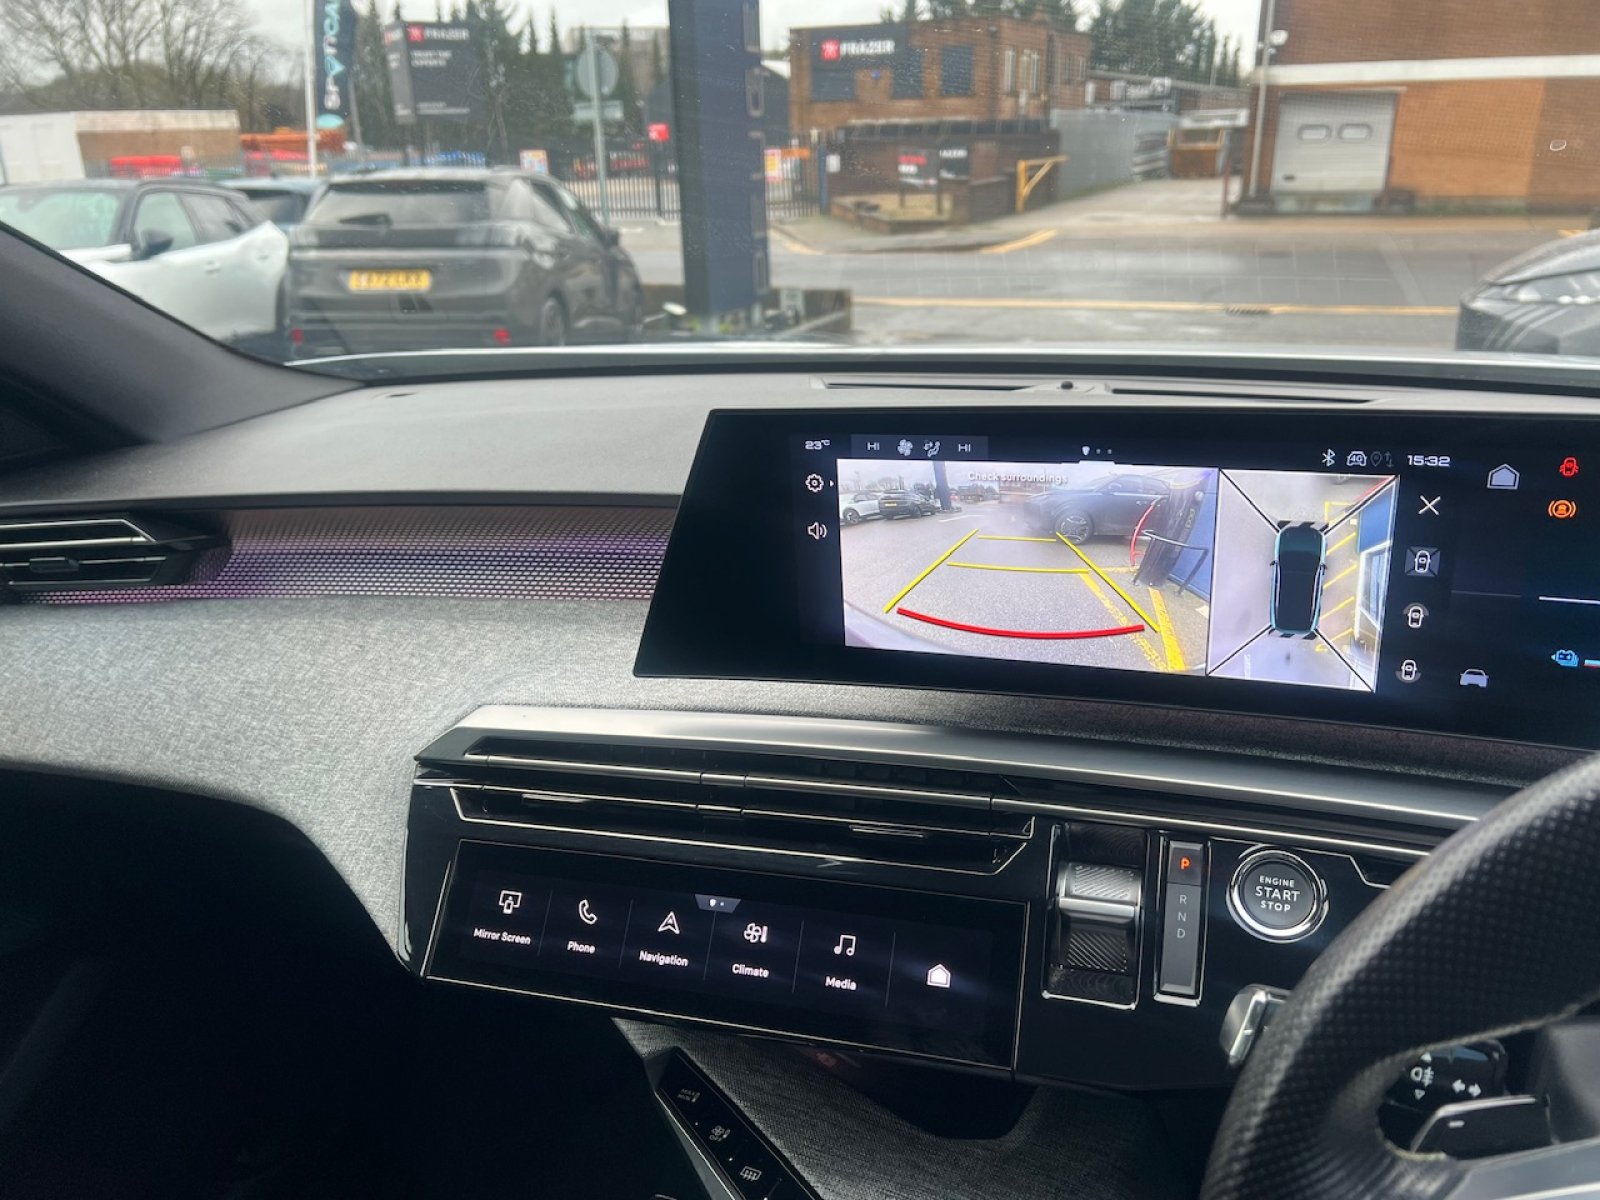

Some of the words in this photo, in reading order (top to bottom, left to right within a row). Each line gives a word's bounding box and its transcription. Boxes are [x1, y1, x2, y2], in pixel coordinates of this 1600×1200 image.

[840, 39, 895, 56] FRAZER
[866, 441, 881, 451] HI
[957, 443, 972, 453] HI
[1407, 453, 1451, 468] 15:32
[968, 471, 1000, 481] Check
[1002, 474, 1068, 485] surroundings
[1180, 857, 1190, 870] P
[1259, 875, 1295, 888] ENGINE
[1179, 894, 1188, 905] R
[1254, 885, 1301, 903] START
[1260, 900, 1291, 913] STOP
[1177, 911, 1187, 922] N
[473, 928, 501, 941] Mirror
[501, 931, 531, 945] Screen
[1177, 928, 1186, 939] D
[567, 940, 595, 955] Phone
[639, 950, 689, 966] Navigation
[731, 963, 770, 979] Climate
[825, 975, 857, 991] Media
